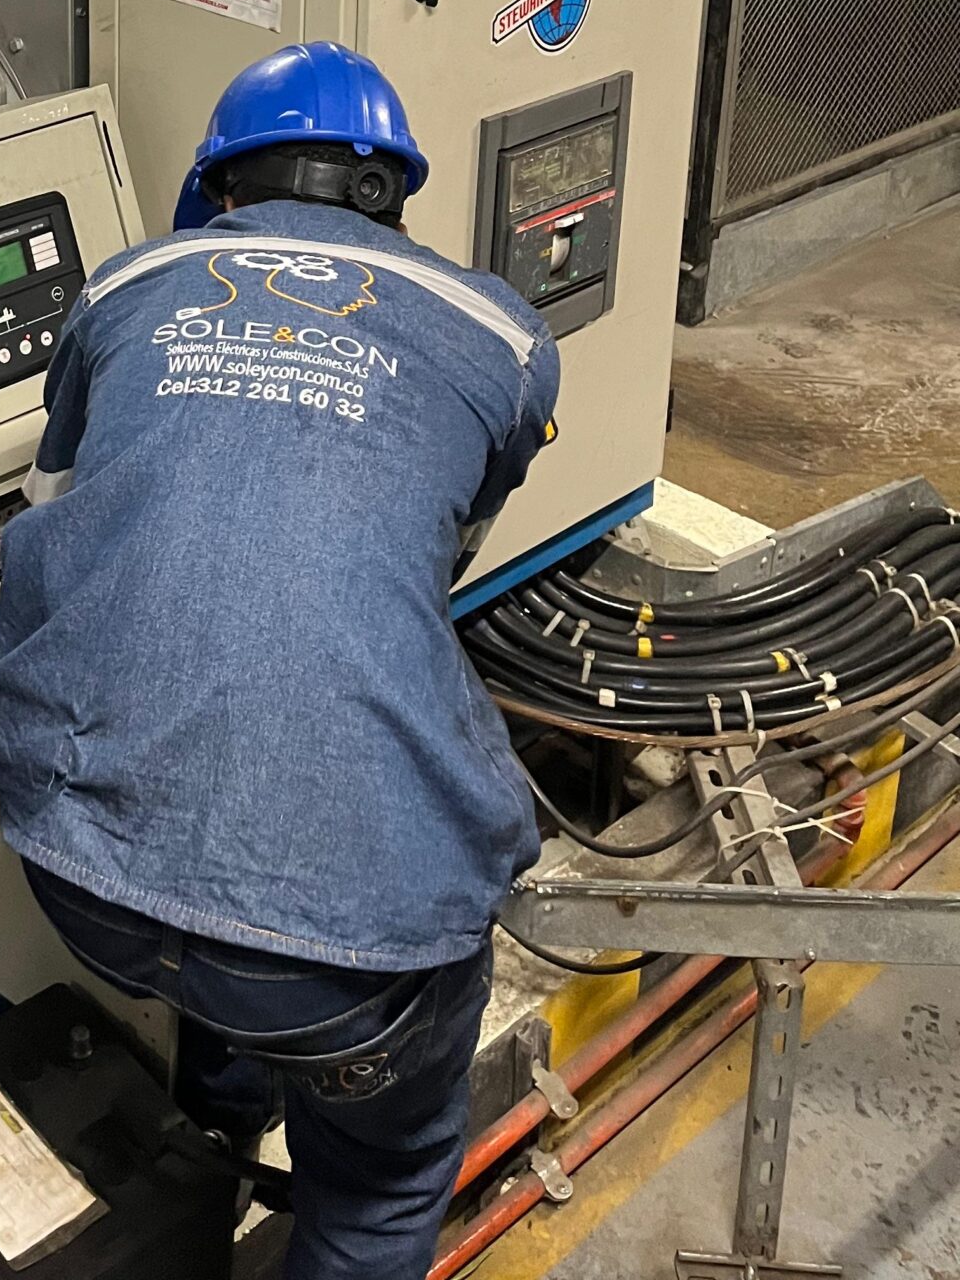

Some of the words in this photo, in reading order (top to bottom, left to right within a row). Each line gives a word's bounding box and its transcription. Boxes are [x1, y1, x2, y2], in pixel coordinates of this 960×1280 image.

[151, 318, 399, 378] SOLE&CON
[165, 342, 214, 356] Soluciones
[215, 341, 261, 358] Eléctricas
[261, 348, 269, 360] y
[246, 382, 292, 402] 261
[299, 387, 329, 409] 60
[335, 398, 366, 422] 32
